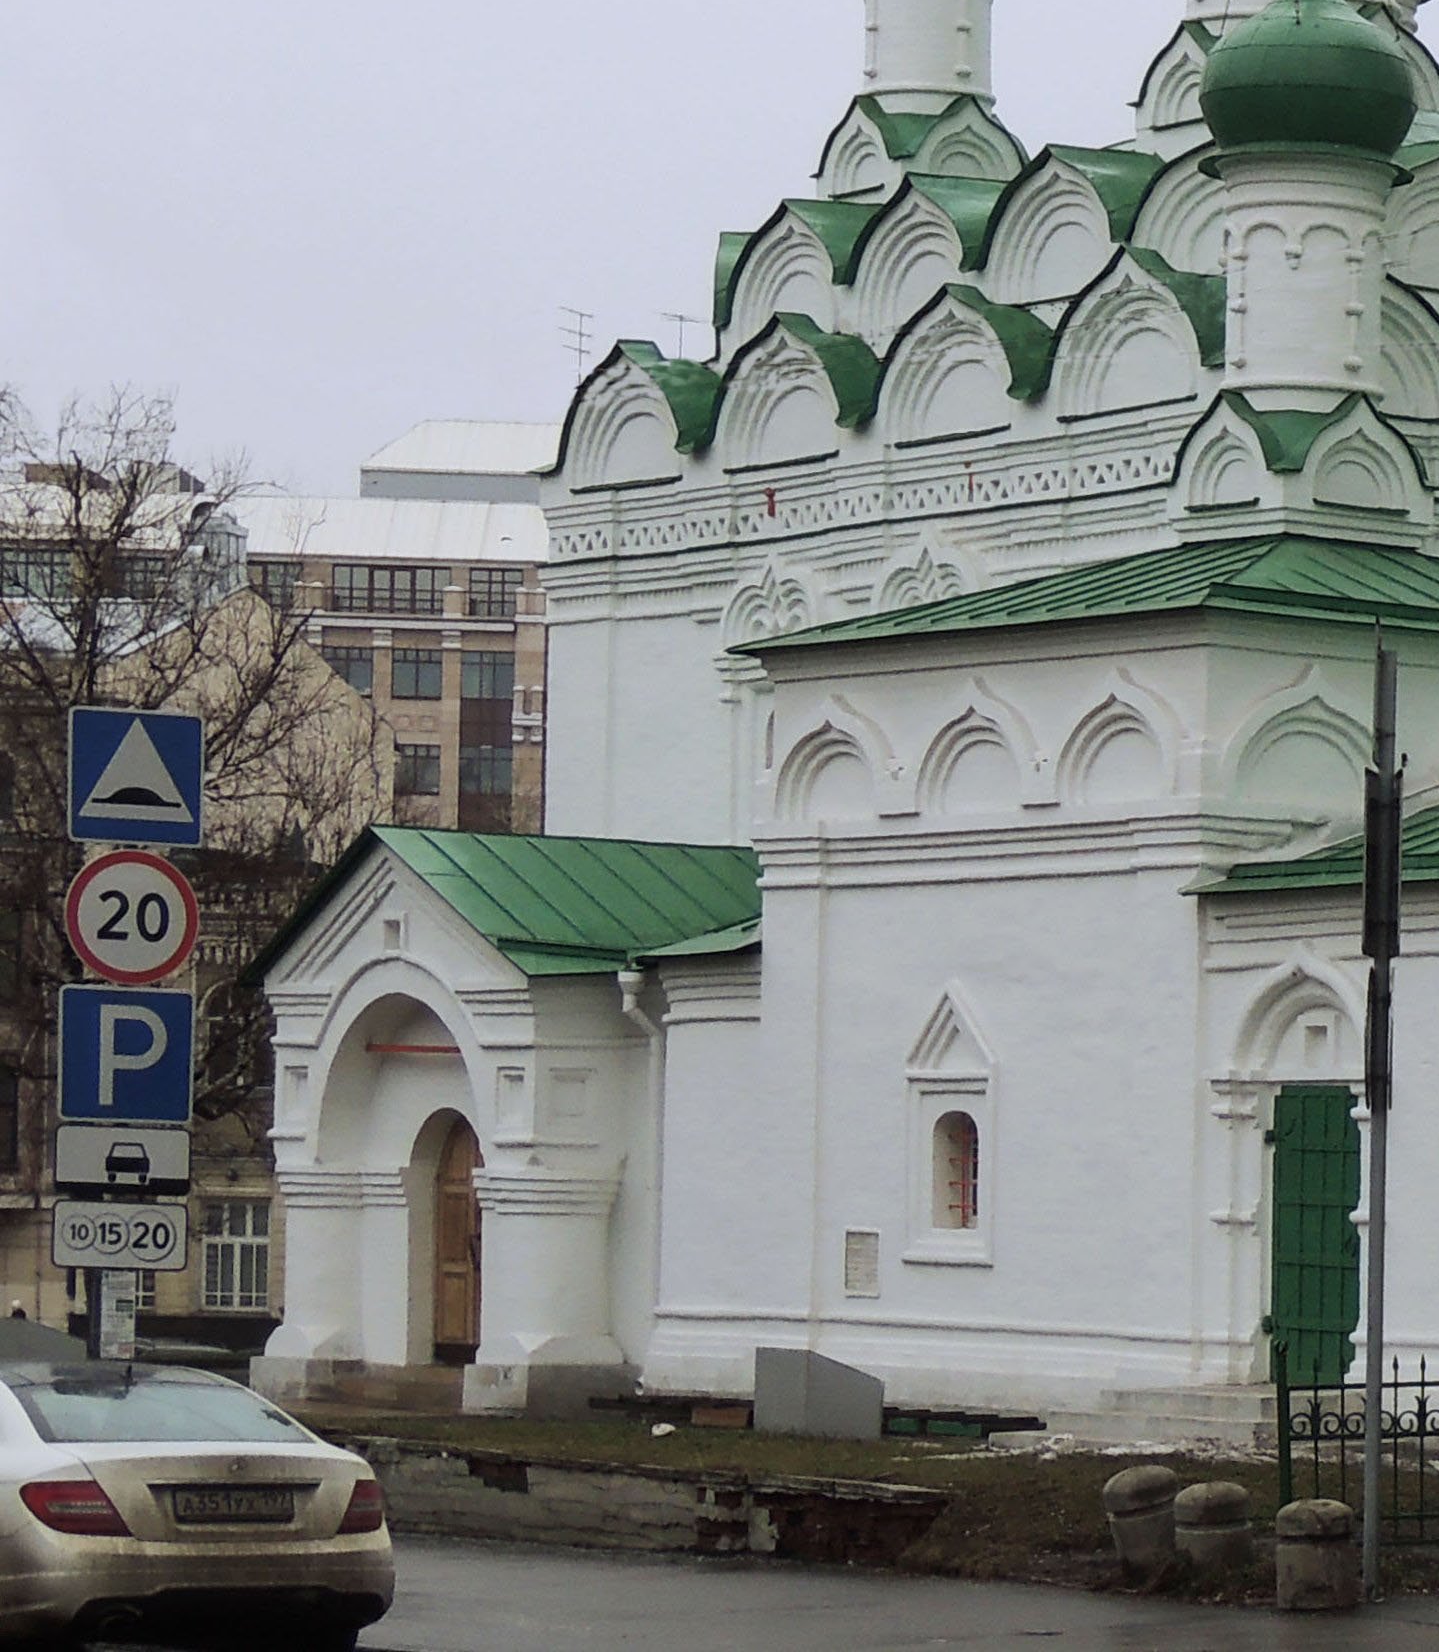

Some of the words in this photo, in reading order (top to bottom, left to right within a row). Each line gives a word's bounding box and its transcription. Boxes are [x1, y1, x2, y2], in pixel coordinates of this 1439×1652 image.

[97, 889, 170, 943] 20
[98, 1003, 168, 1106] P
[70, 1223, 90, 1241] 10
[98, 1222, 123, 1246] 15
[131, 1221, 170, 1250] 20
